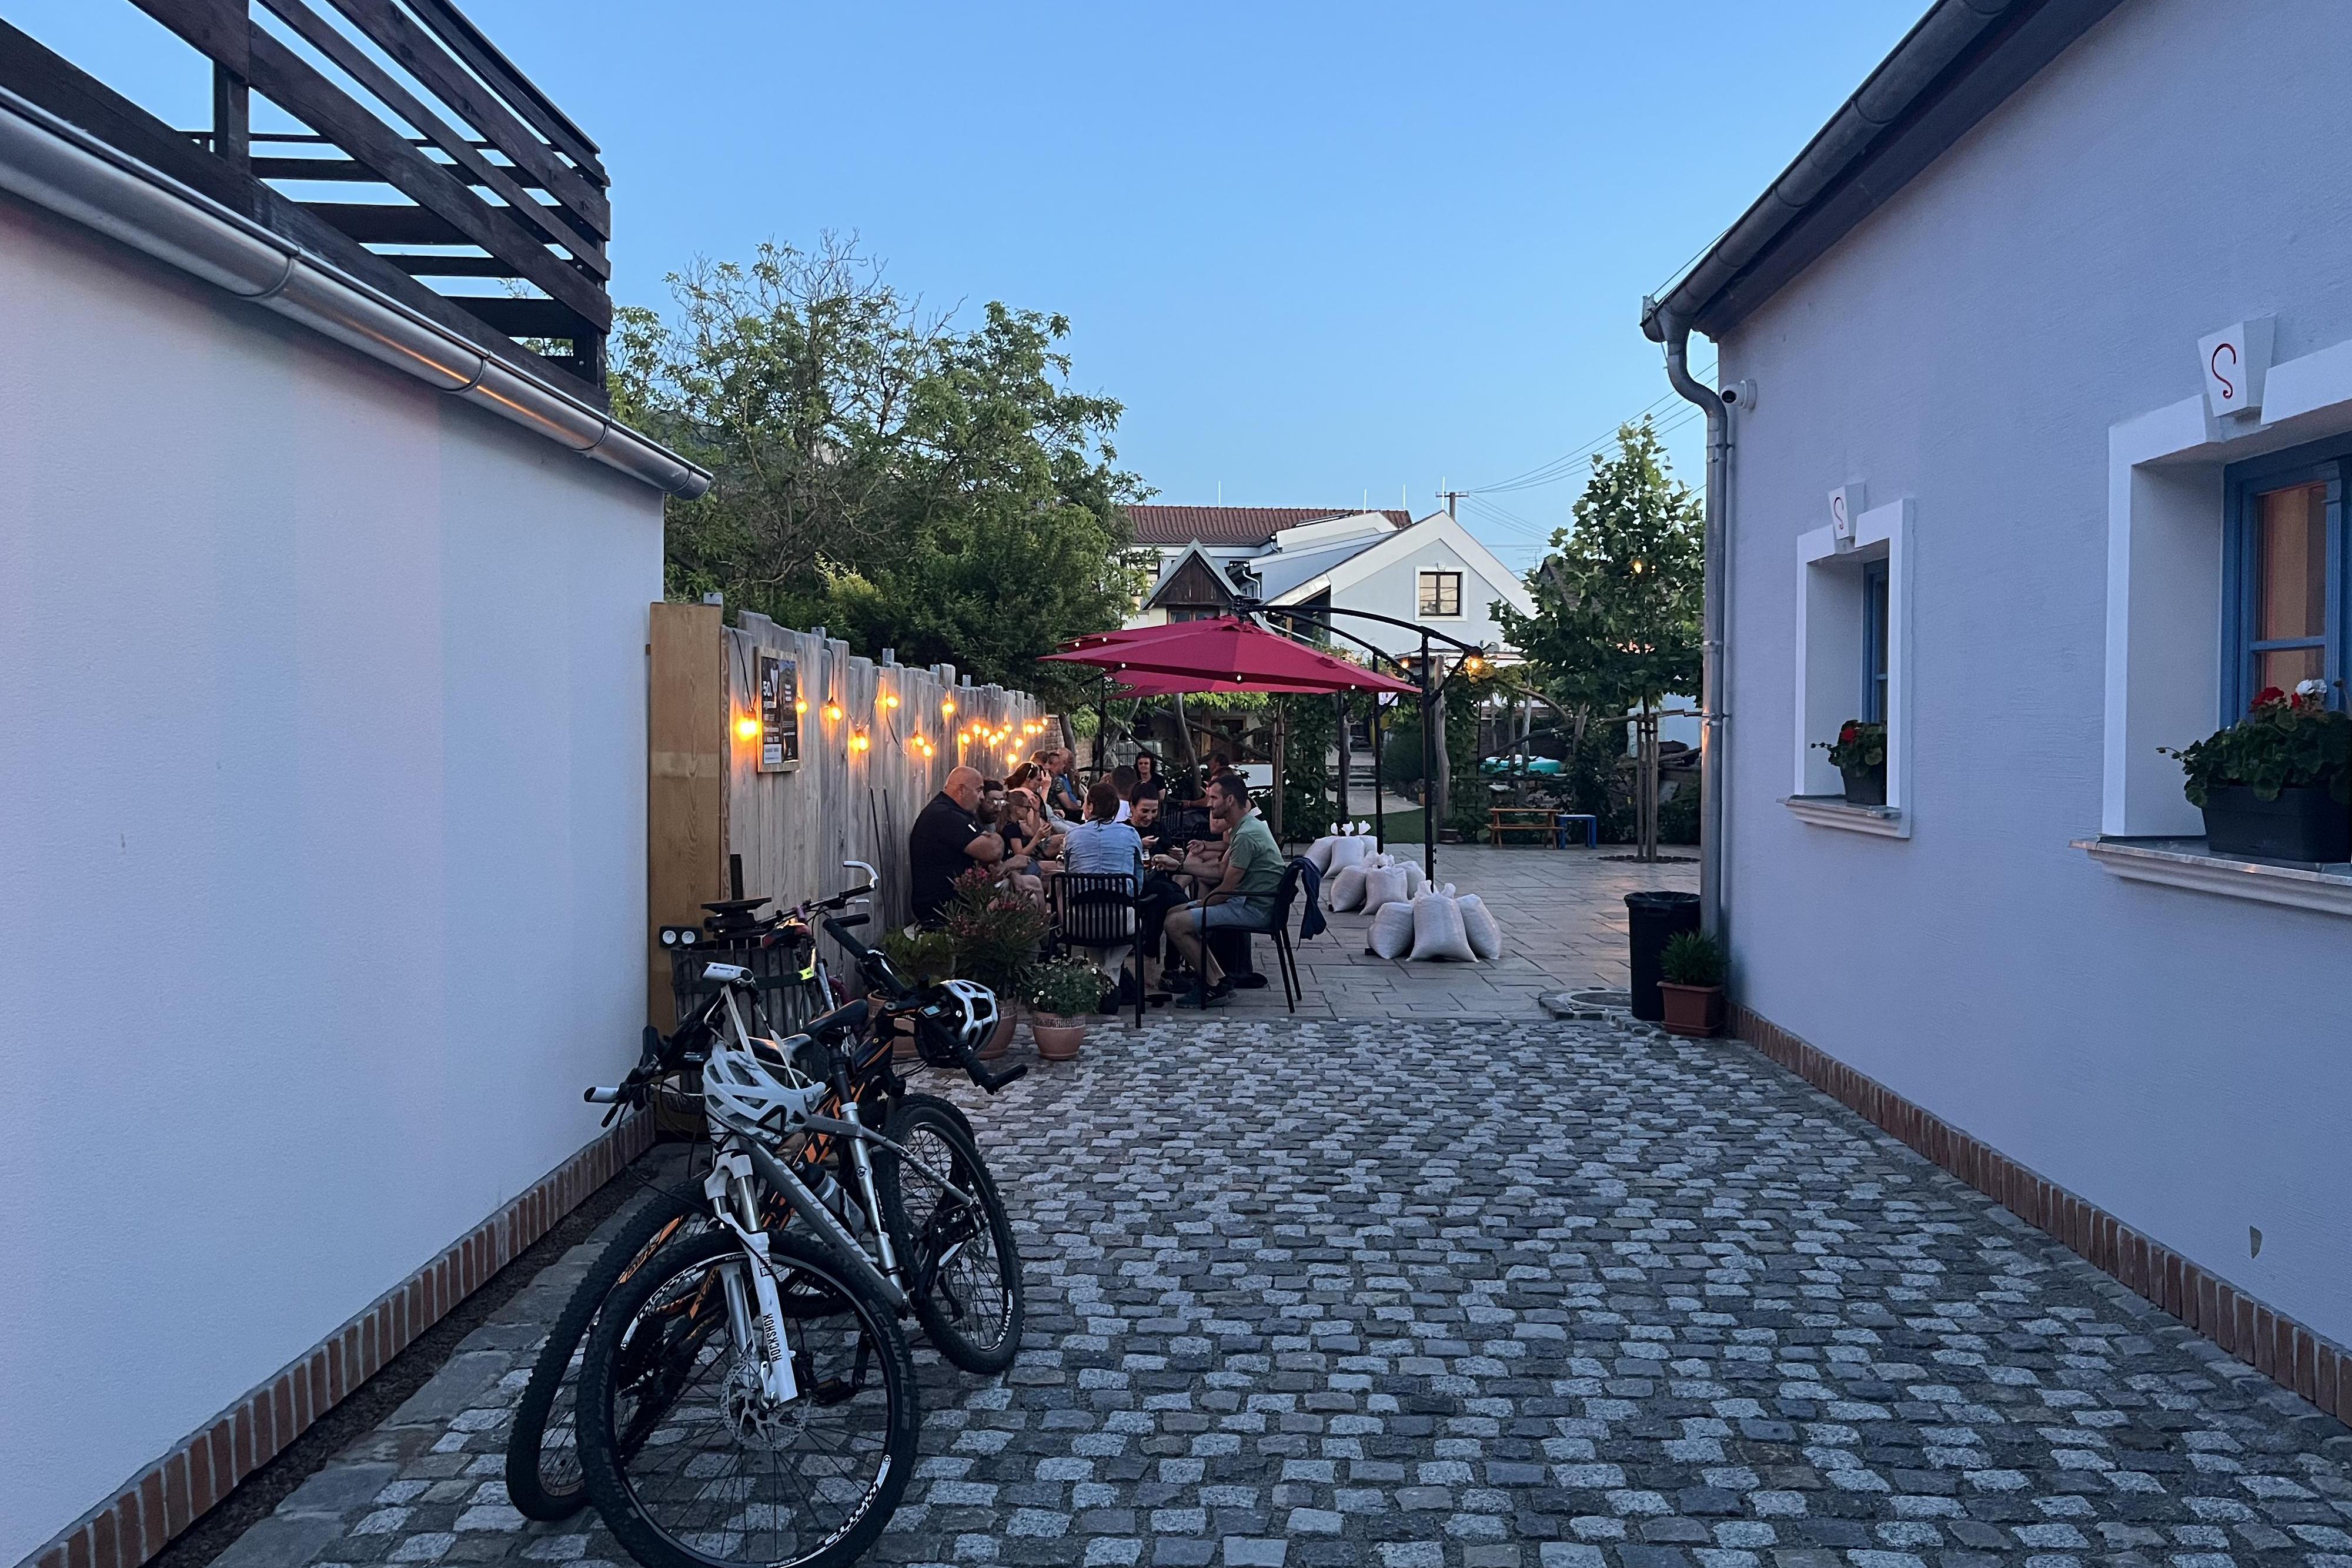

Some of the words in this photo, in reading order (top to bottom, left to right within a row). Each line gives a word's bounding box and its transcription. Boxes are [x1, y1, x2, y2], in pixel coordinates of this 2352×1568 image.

[773, 1158, 873, 1263] MERIDA
[763, 1313, 783, 1362] ROCKSHOX
[864, 1298, 911, 1430] SCHWALBE
